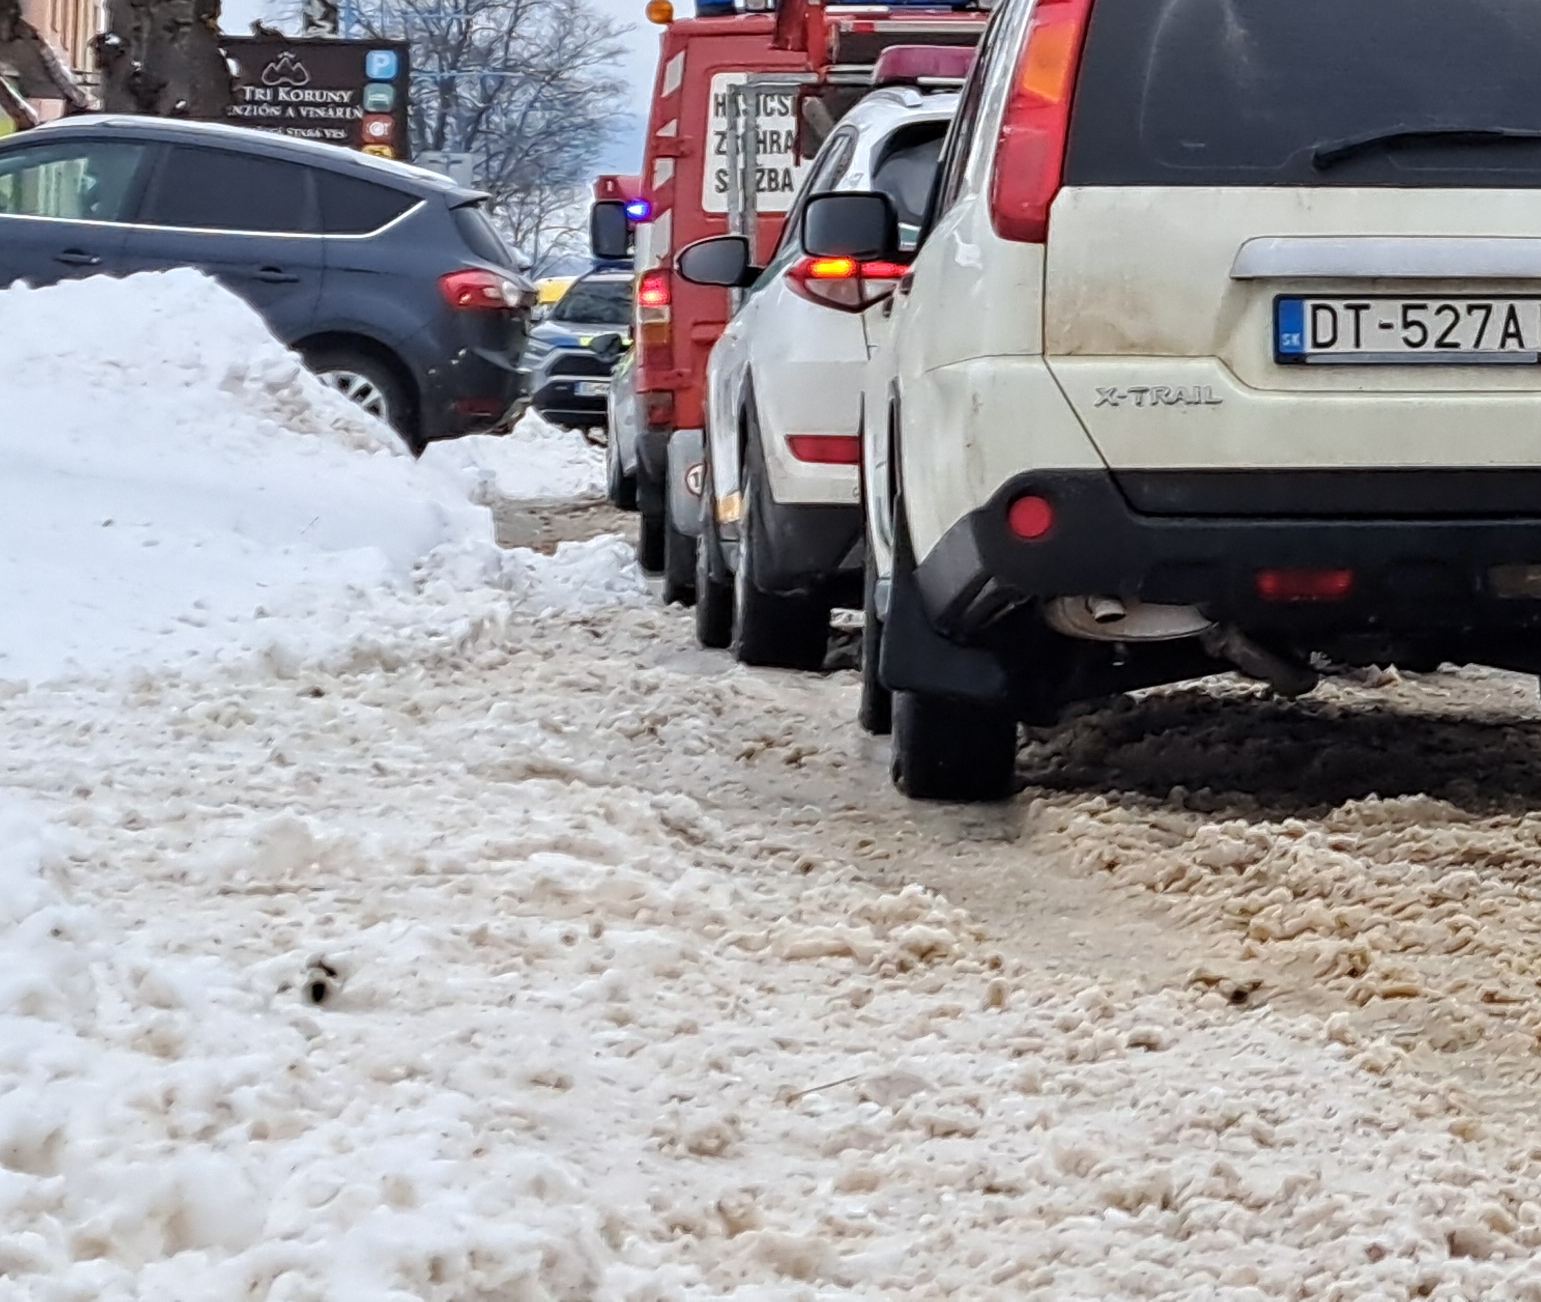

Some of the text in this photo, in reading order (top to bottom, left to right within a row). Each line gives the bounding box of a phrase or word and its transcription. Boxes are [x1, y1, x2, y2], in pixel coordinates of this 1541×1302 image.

[243, 85, 353, 104] TRI KORUNY
[1093, 385, 1224, 408] X-TRAIL
